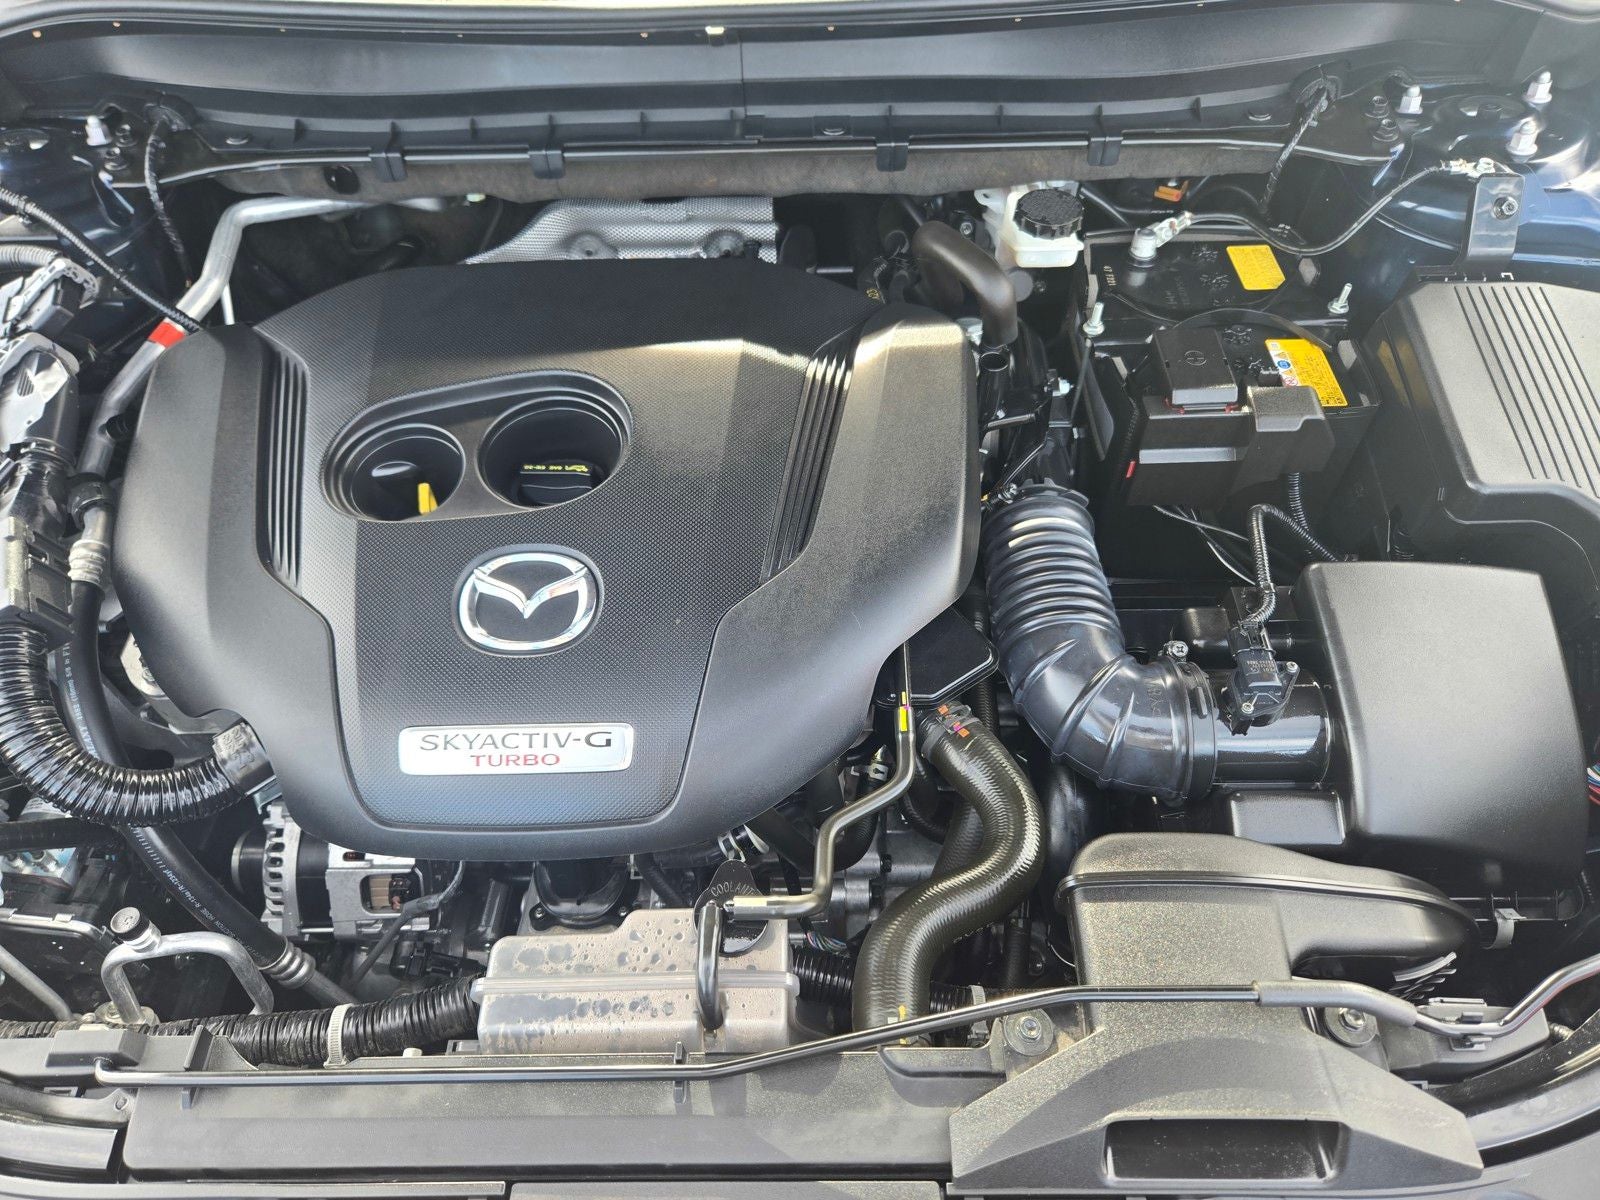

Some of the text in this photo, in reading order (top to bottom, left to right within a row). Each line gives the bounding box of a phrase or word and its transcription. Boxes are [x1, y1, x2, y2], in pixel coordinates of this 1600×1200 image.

[419, 731, 613, 751] SKYACTIV-G
[470, 753, 561, 767] TURBO
[711, 881, 756, 897] COOLANT
